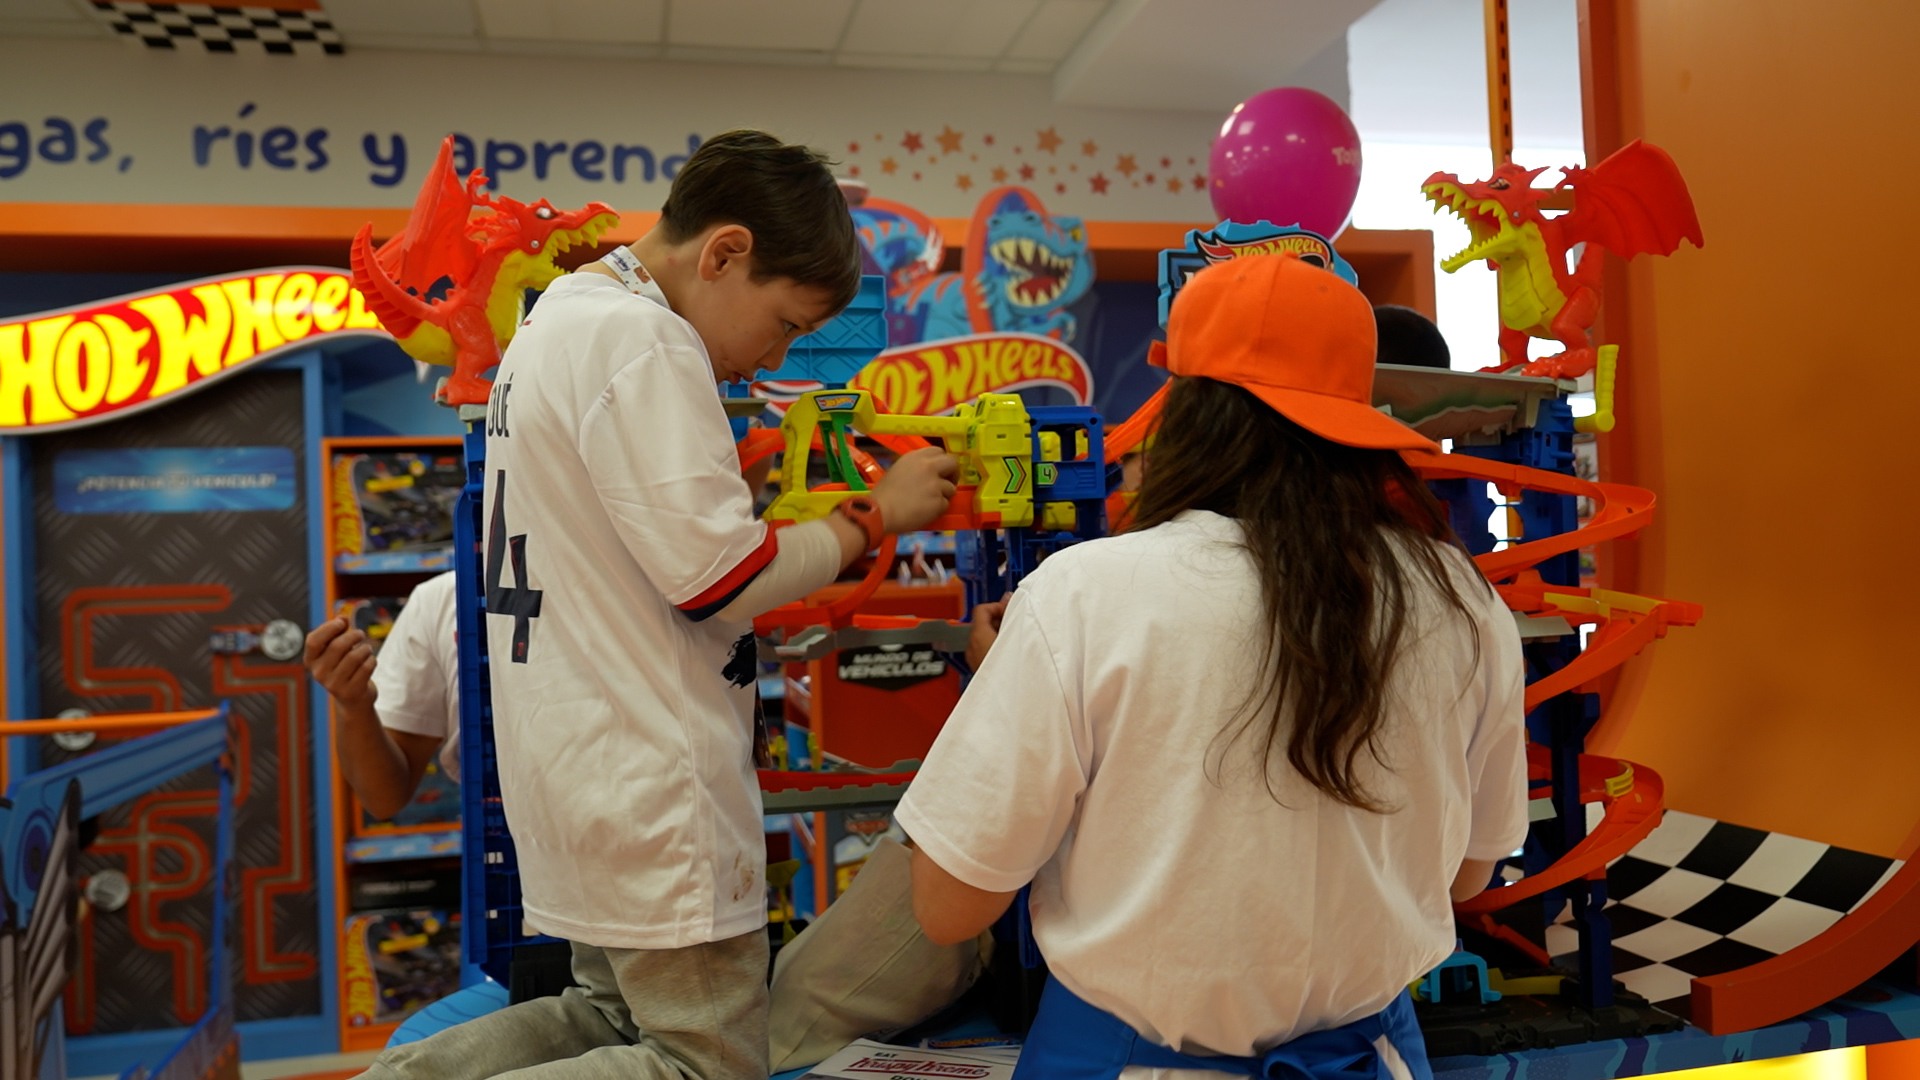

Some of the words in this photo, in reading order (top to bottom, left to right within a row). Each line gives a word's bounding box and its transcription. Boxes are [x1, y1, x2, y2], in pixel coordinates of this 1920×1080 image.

[193, 102, 330, 172] ríes
[362, 132, 407, 188] y
[1043, 466, 1052, 480] 4
[485, 468, 543, 665] 4
